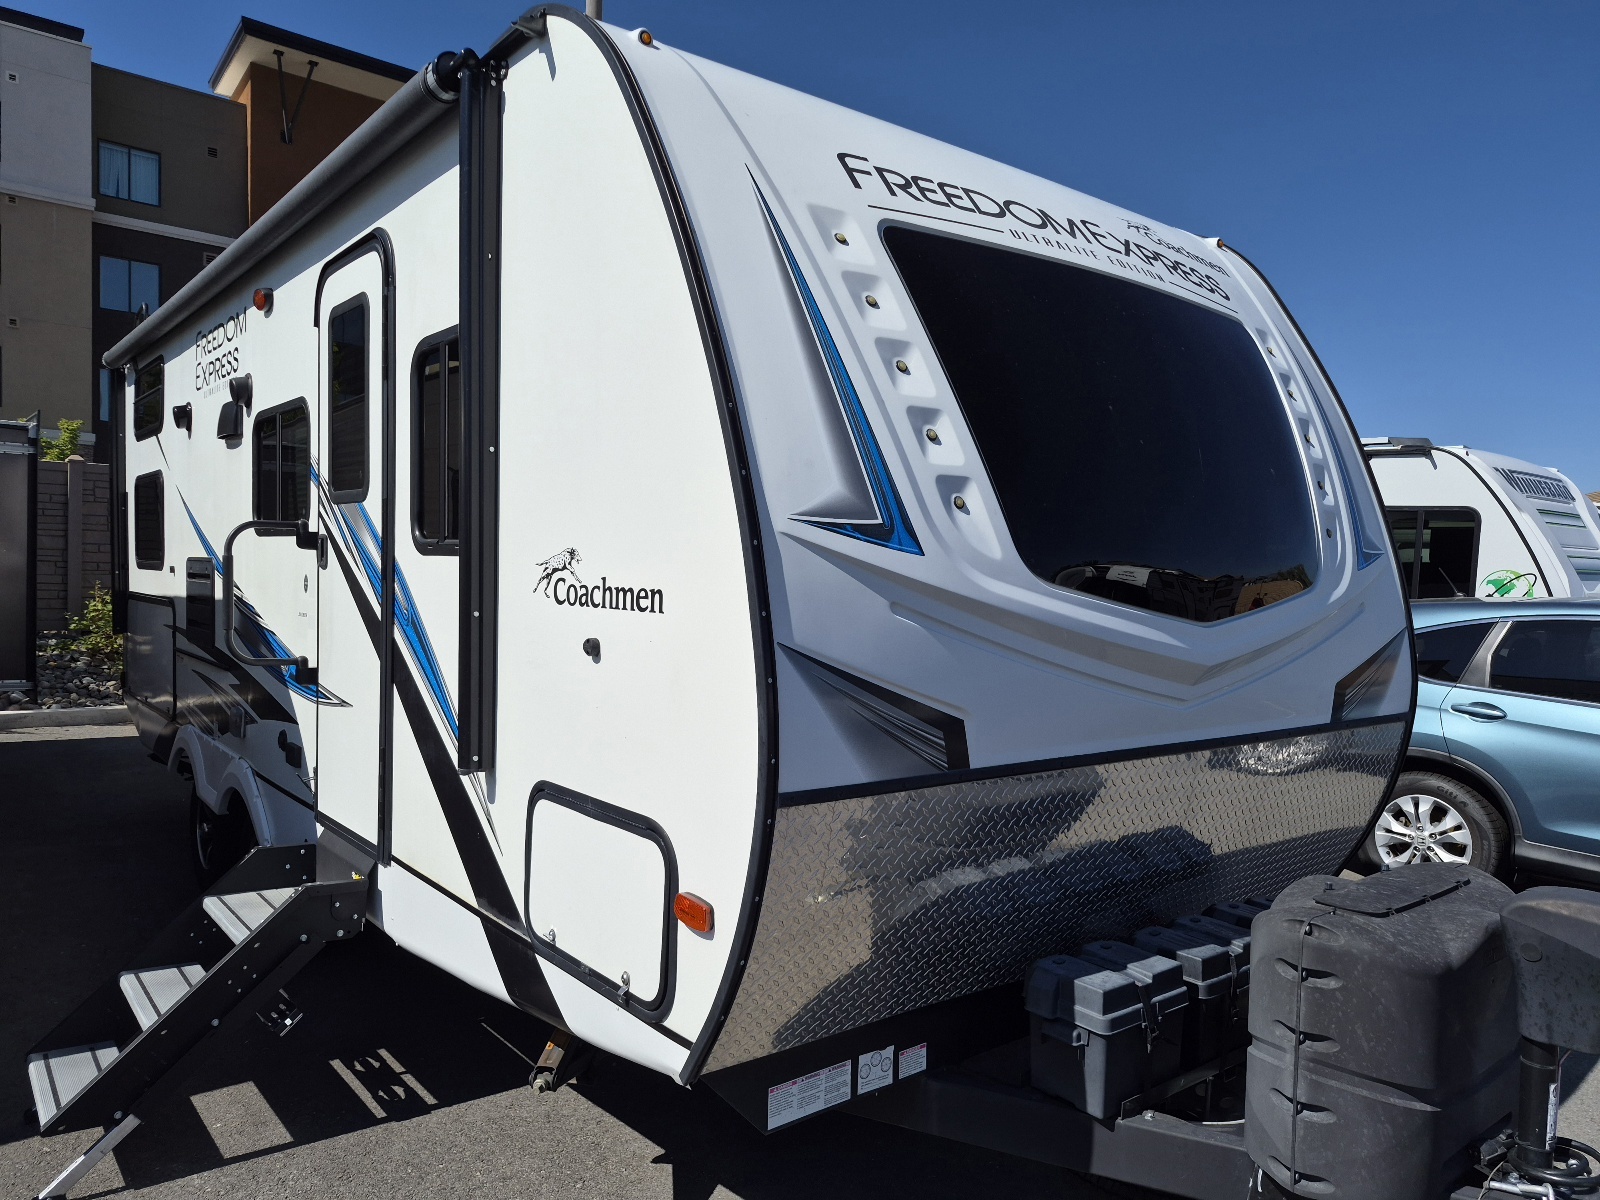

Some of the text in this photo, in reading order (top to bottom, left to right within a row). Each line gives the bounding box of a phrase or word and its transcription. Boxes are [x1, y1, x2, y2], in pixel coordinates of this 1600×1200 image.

[1008, 228, 1167, 283] ULTRALITE EDITION
[1143, 231, 1232, 278] Coachmen
[195, 305, 248, 362] FREEDOM
[195, 346, 240, 392] EXPRESS
[553, 576, 665, 614] Coachmen
